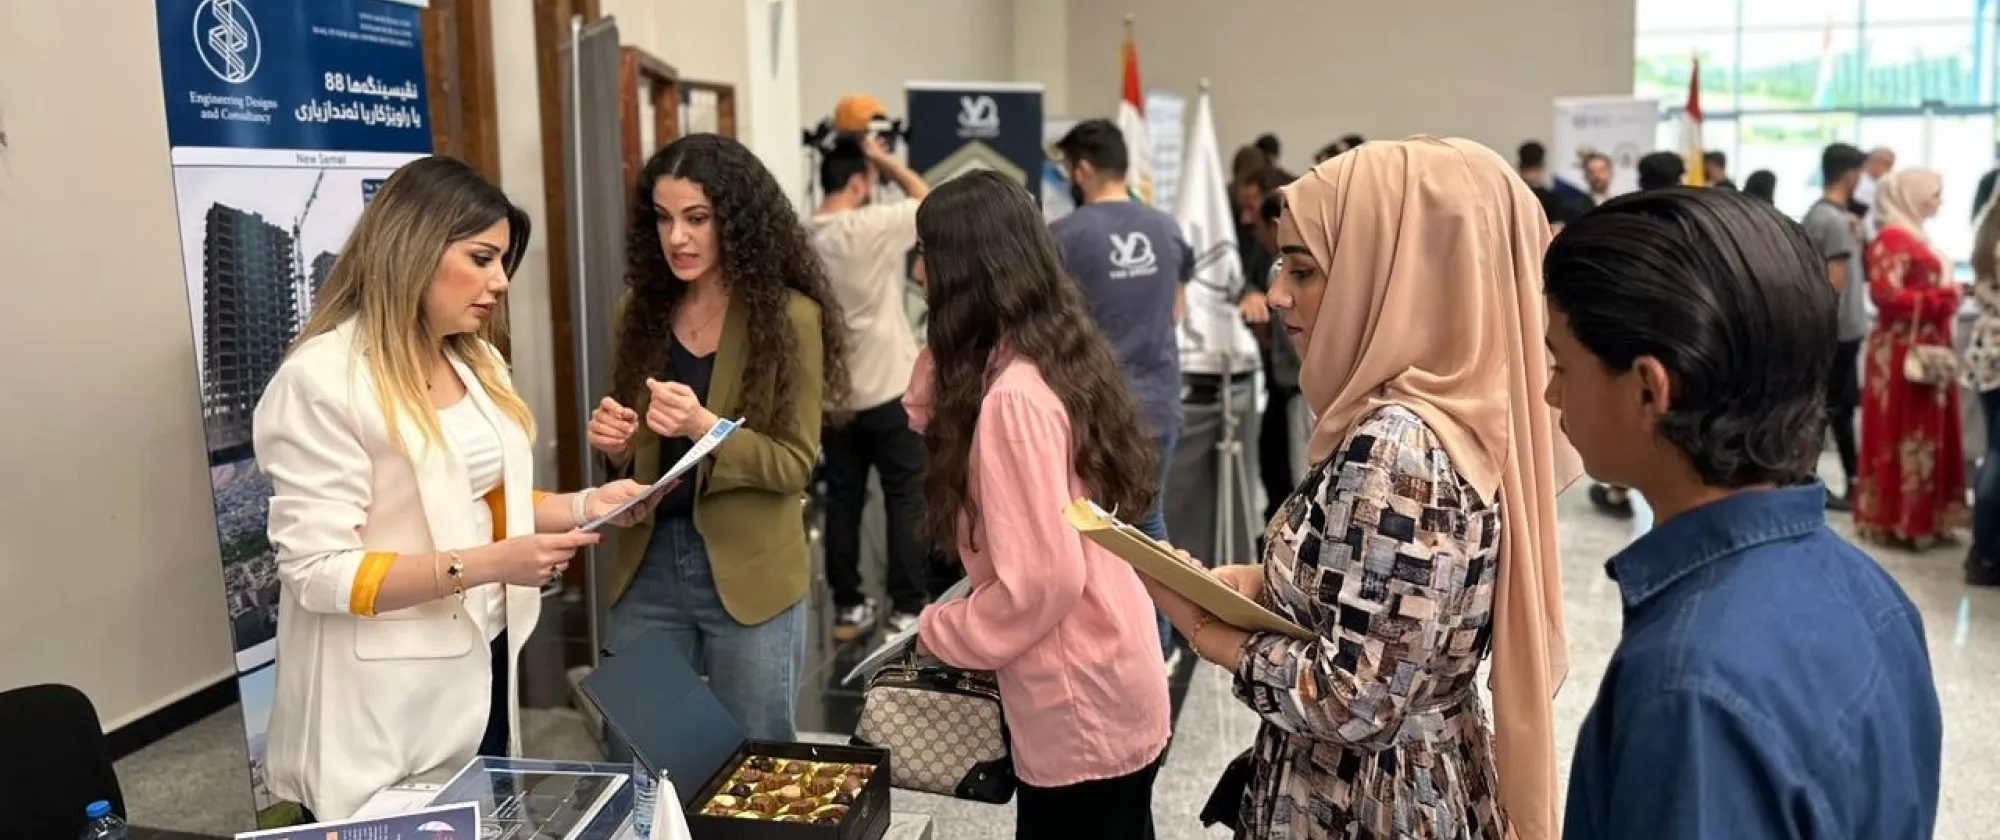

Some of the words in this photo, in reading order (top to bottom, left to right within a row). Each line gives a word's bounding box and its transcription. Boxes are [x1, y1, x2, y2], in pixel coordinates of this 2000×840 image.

[324, 71, 345, 92] 88
[189, 91, 243, 108] Engineering
[244, 96, 278, 110] Designs
[200, 108, 219, 119] and
[221, 108, 271, 125] Consultancy
